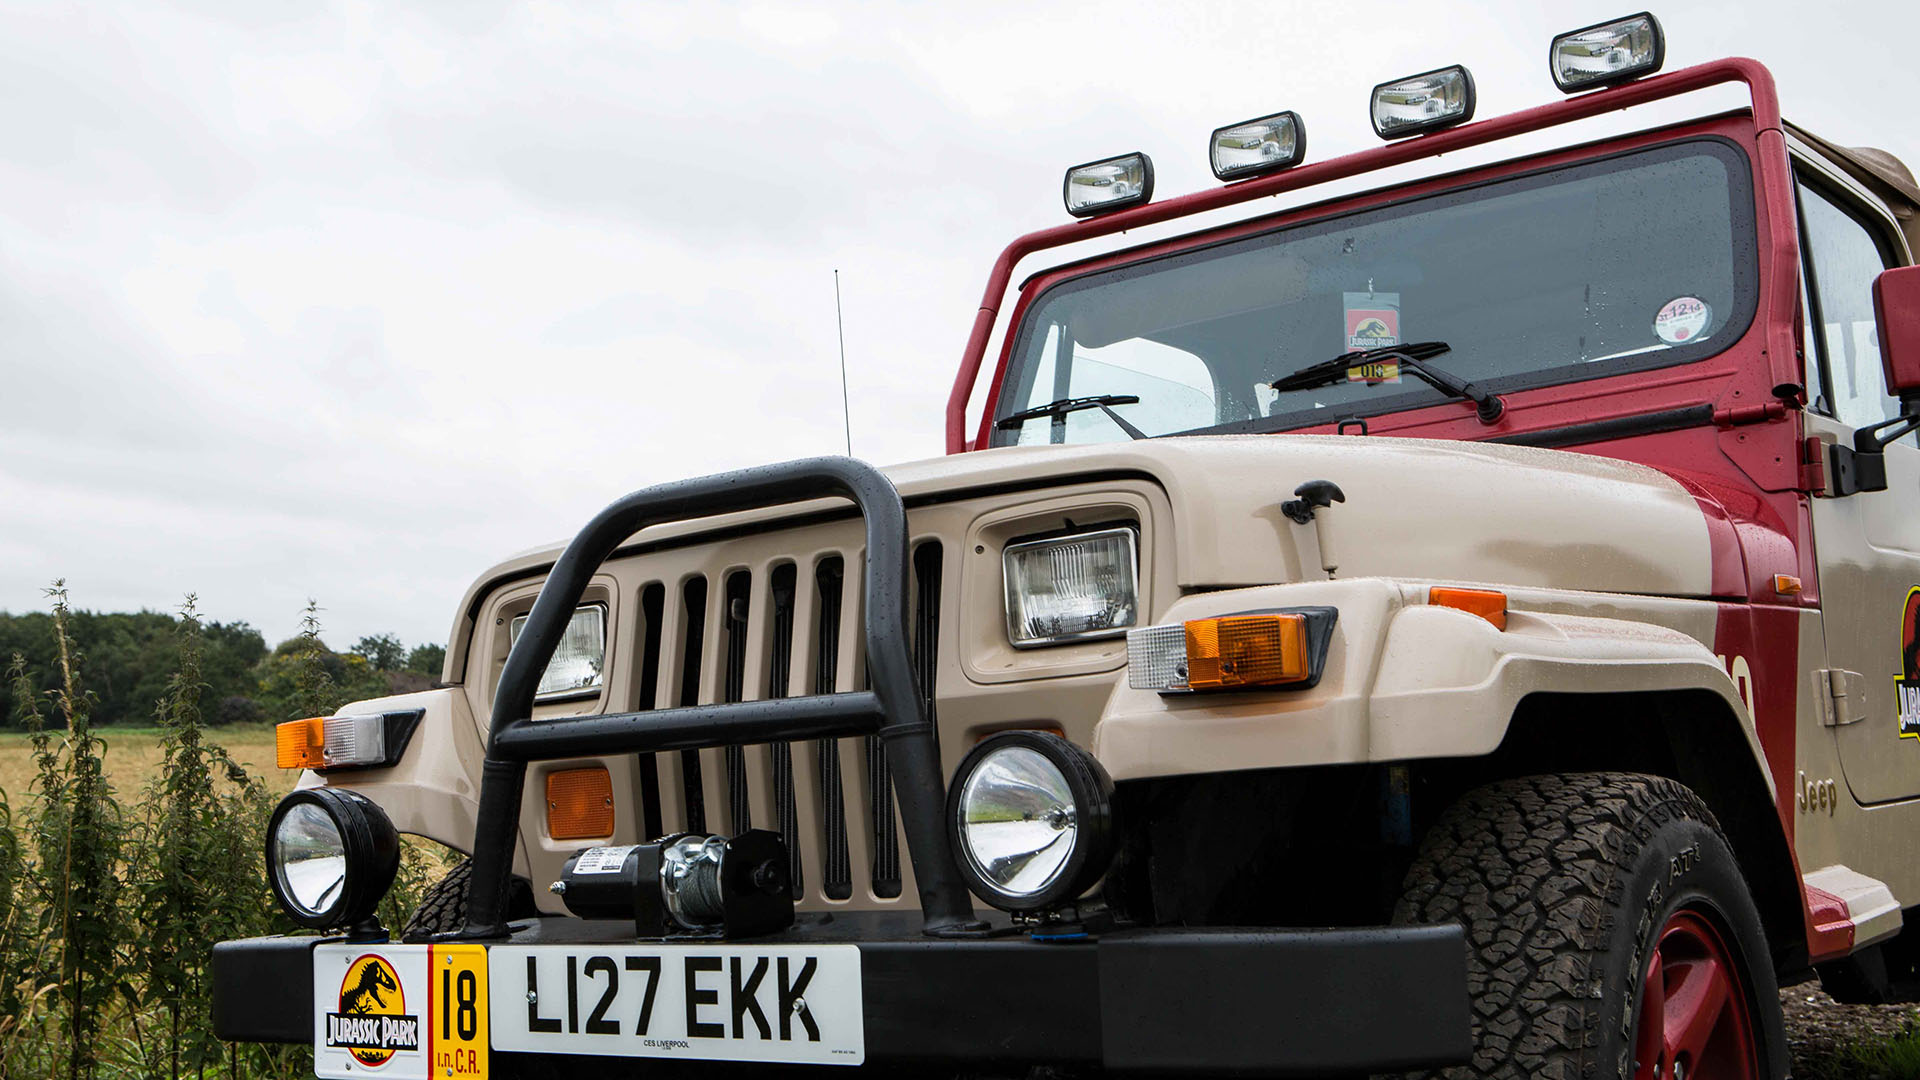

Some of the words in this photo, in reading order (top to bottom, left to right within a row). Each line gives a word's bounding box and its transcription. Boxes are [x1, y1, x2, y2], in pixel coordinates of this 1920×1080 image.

[1671, 303, 1688, 317] 12
[1352, 337, 1377, 346] JURASSIC
[1378, 337, 1394, 347] PARK
[1361, 364, 1384, 378] 018
[1798, 770, 1837, 817] Jeep
[442, 969, 477, 1041] 18
[526, 956, 662, 1036] L127
[684, 956, 821, 1042] EKK
[327, 1014, 380, 1046] JURASSIC
[381, 1015, 418, 1048] PARK
[643, 1039, 656, 1047] CES
[656, 1040, 690, 1049] LIVERPOOL
